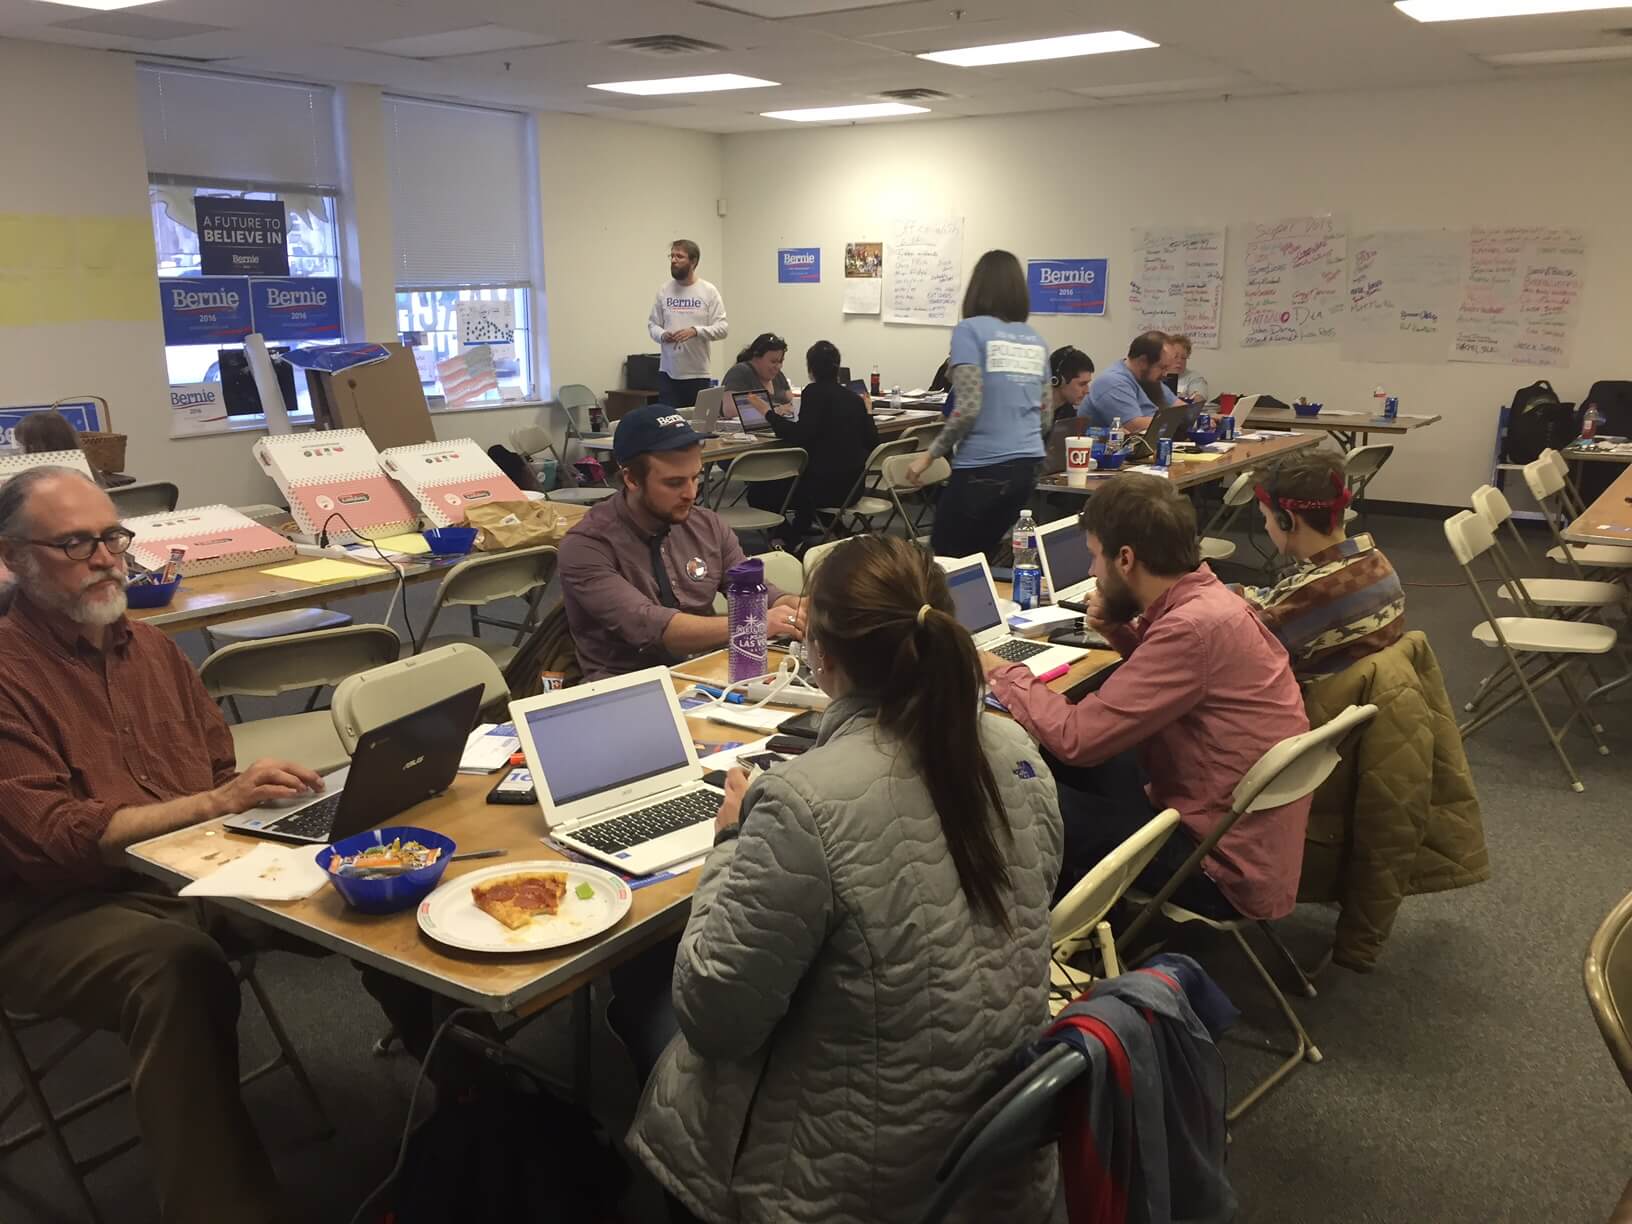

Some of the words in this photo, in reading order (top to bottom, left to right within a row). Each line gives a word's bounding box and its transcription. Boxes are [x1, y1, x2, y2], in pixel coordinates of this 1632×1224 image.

[203, 216, 211, 227] A
[215, 216, 262, 229] FUTURE
[265, 218, 281, 230] TO
[204, 229, 264, 244] BELIEVE
[268, 231, 282, 244] IN
[232, 254, 259, 264] Bernie
[784, 252, 815, 264] Bernie
[1040, 266, 1095, 285] Bernie
[172, 287, 240, 308] Bernie
[266, 286, 327, 306] Bernie
[1059, 288, 1074, 296] 2016
[666, 297, 701, 308] Bernie
[199, 314, 217, 322] 2016
[170, 389, 216, 405] Bernie
[656, 414, 686, 428] Bern
[1070, 450, 1088, 465] QT
